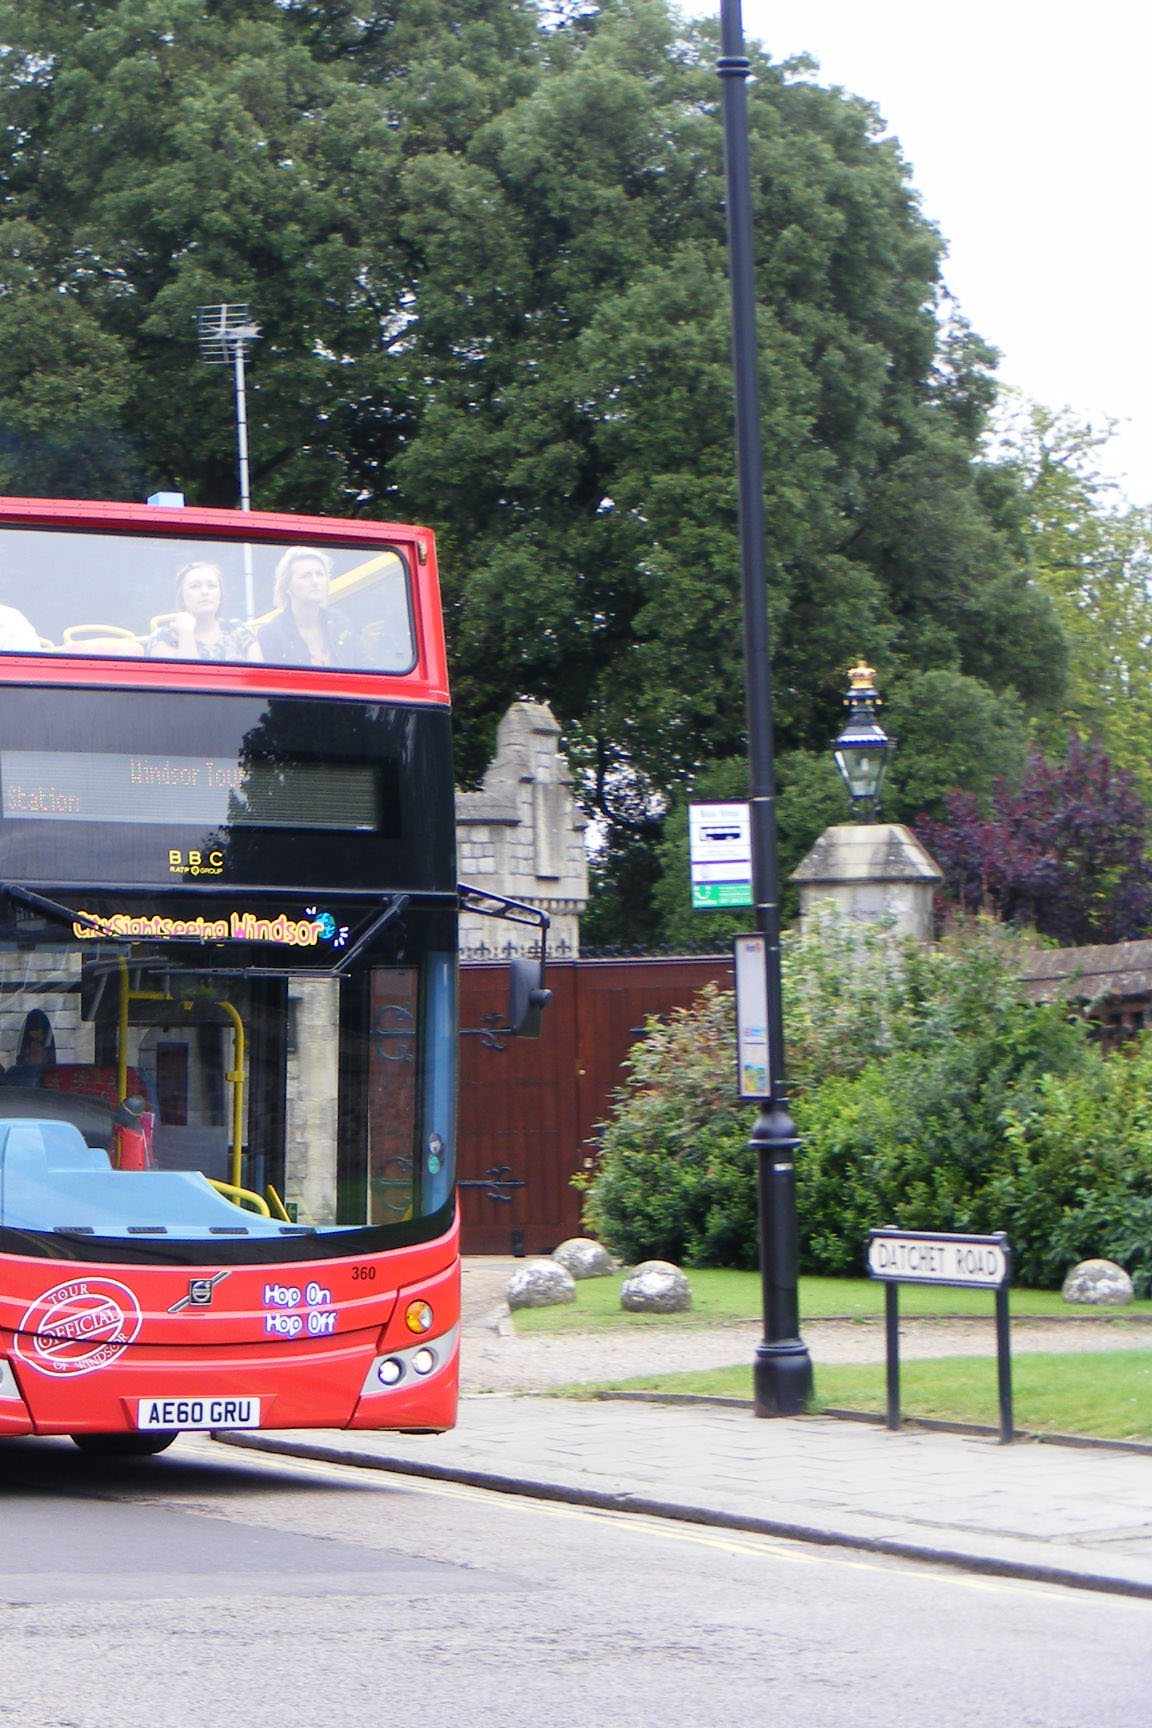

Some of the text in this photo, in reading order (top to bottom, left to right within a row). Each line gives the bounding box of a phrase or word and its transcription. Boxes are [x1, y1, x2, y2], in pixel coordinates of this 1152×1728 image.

[129, 759, 200, 787] Windsor
[169, 850, 224, 867] BBC
[169, 866, 224, 875] RATP GROUP
[230, 911, 326, 946] Windsor
[351, 1265, 377, 1281] 360
[878, 1243, 997, 1276] DATCHET ROAD
[48, 1283, 89, 1306] TOUR
[264, 1281, 332, 1308] Hop On
[38, 1307, 122, 1349] OFFICIAL
[266, 1309, 337, 1338] Hop Off
[52, 1331, 129, 1371] OF WINDSOR
[148, 1400, 251, 1425] AE60 GRU
